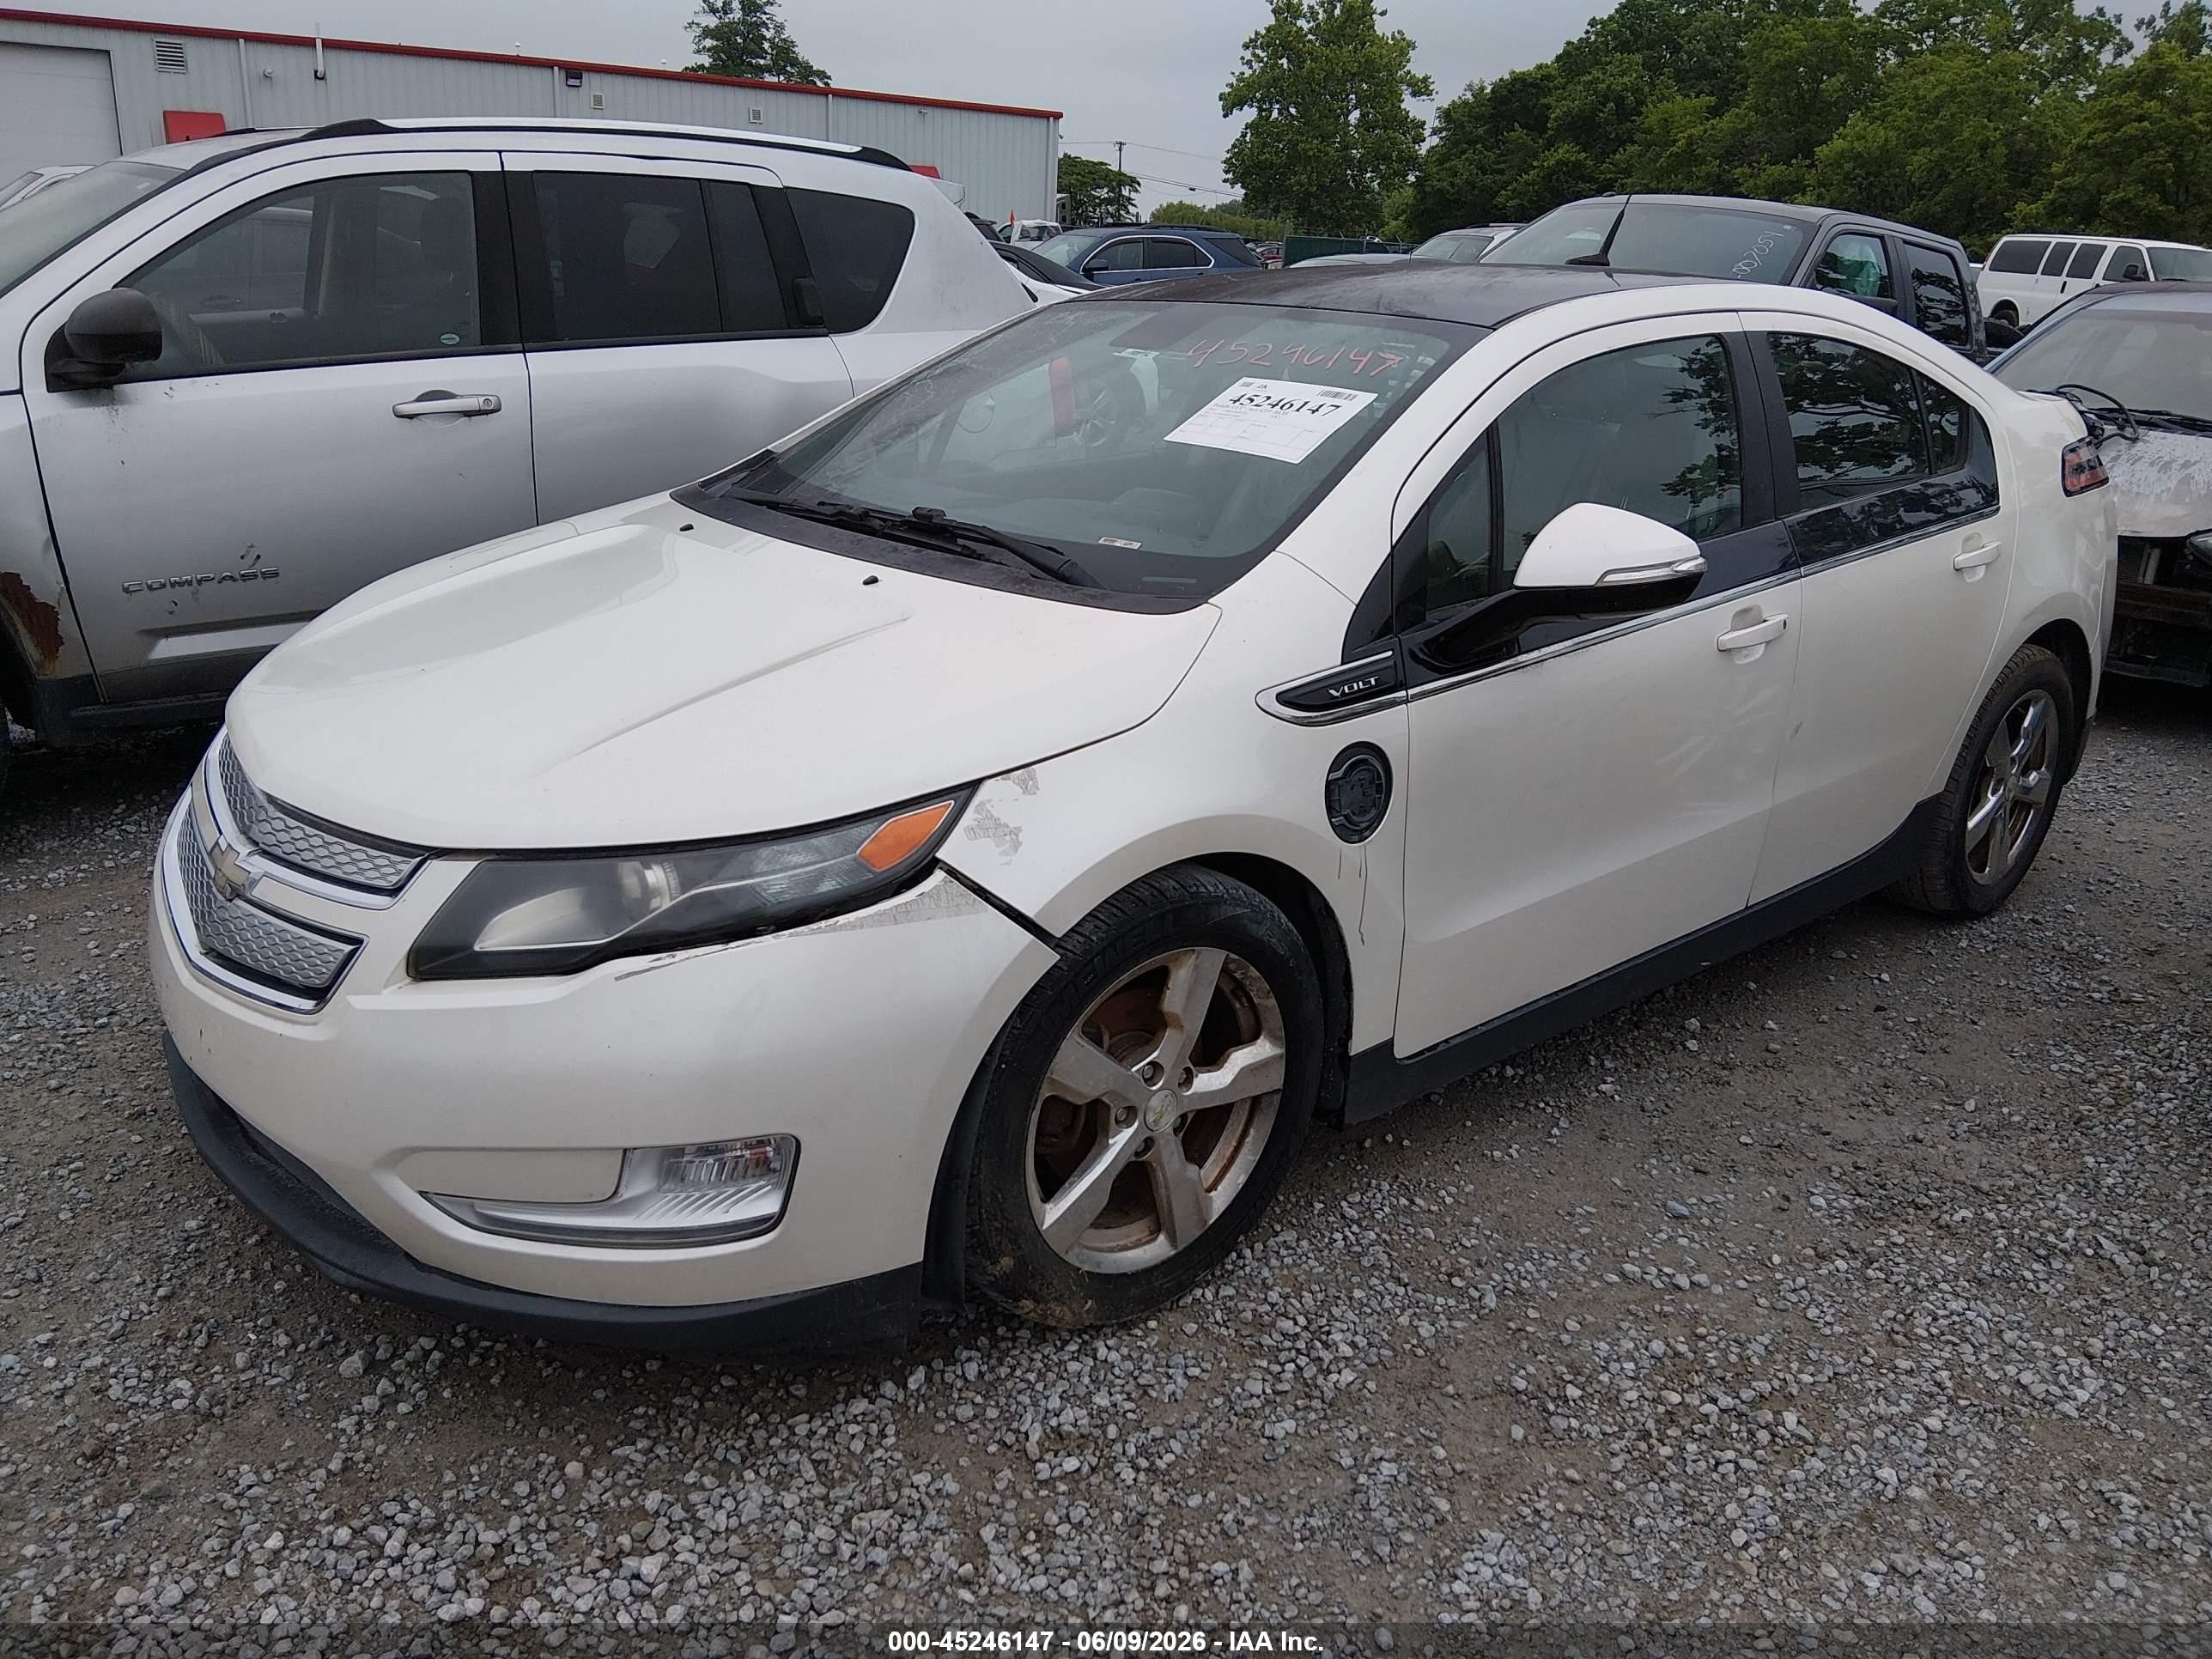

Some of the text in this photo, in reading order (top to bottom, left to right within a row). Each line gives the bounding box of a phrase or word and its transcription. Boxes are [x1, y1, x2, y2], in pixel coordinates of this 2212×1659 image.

[1229, 392, 1341, 416] 45246147
[122, 567, 280, 594] COMPASS
[1328, 676, 1379, 697] VOLT
